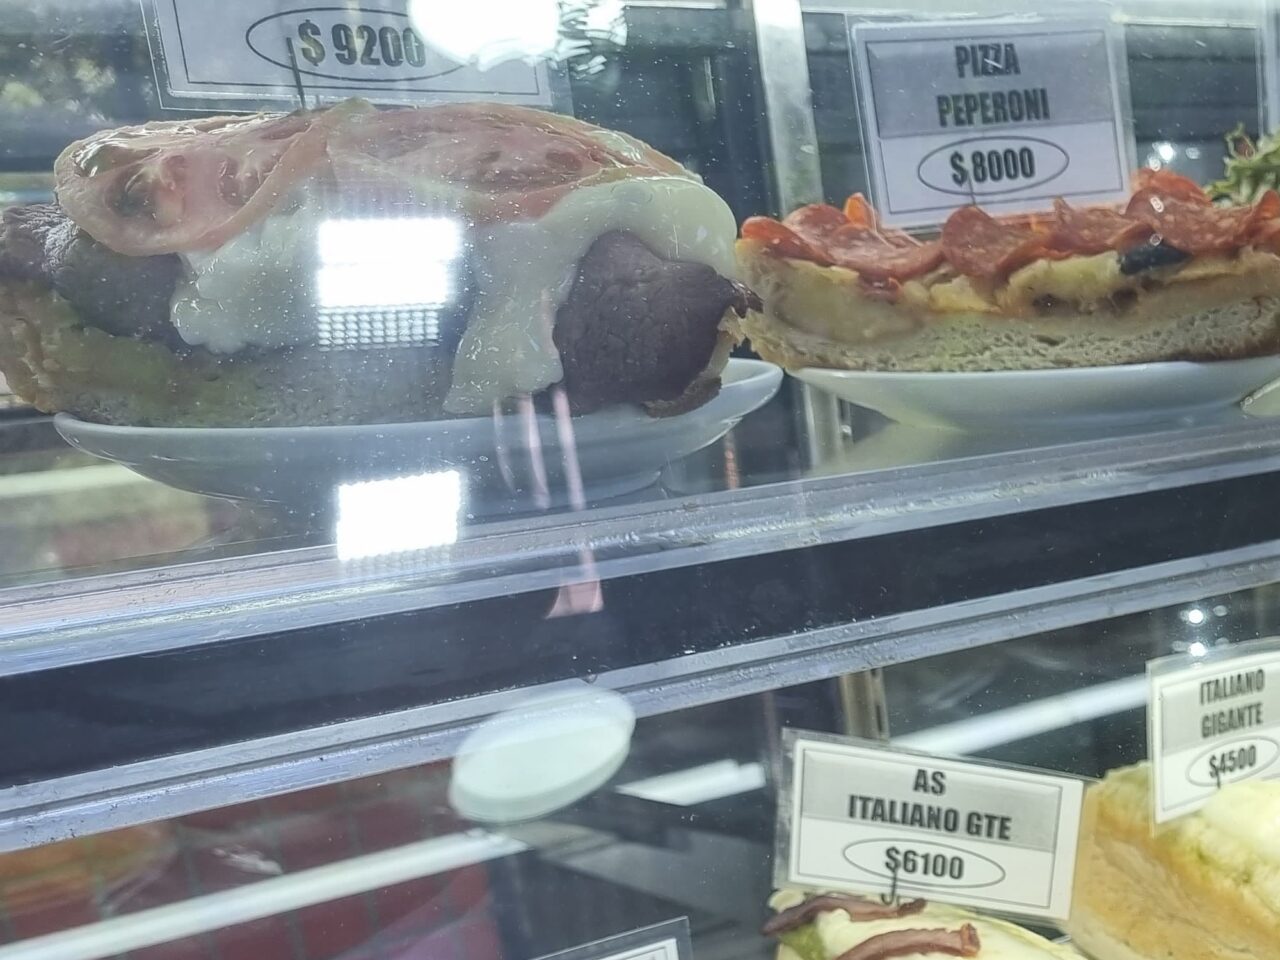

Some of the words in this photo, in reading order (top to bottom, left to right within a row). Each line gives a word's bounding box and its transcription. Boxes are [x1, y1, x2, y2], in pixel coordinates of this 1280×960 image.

[955, 43, 1021, 78] PIZZA
[936, 88, 1050, 128] PEPERONI
[1200, 669, 1265, 706] ITALIANO
[1201, 702, 1264, 739] GIGANTE
[1208, 745, 1257, 779] $4500
[913, 768, 946, 796] AS
[848, 794, 959, 833] ITALIANO
[966, 811, 1013, 841] GTE
[885, 846, 964, 880] $6100
